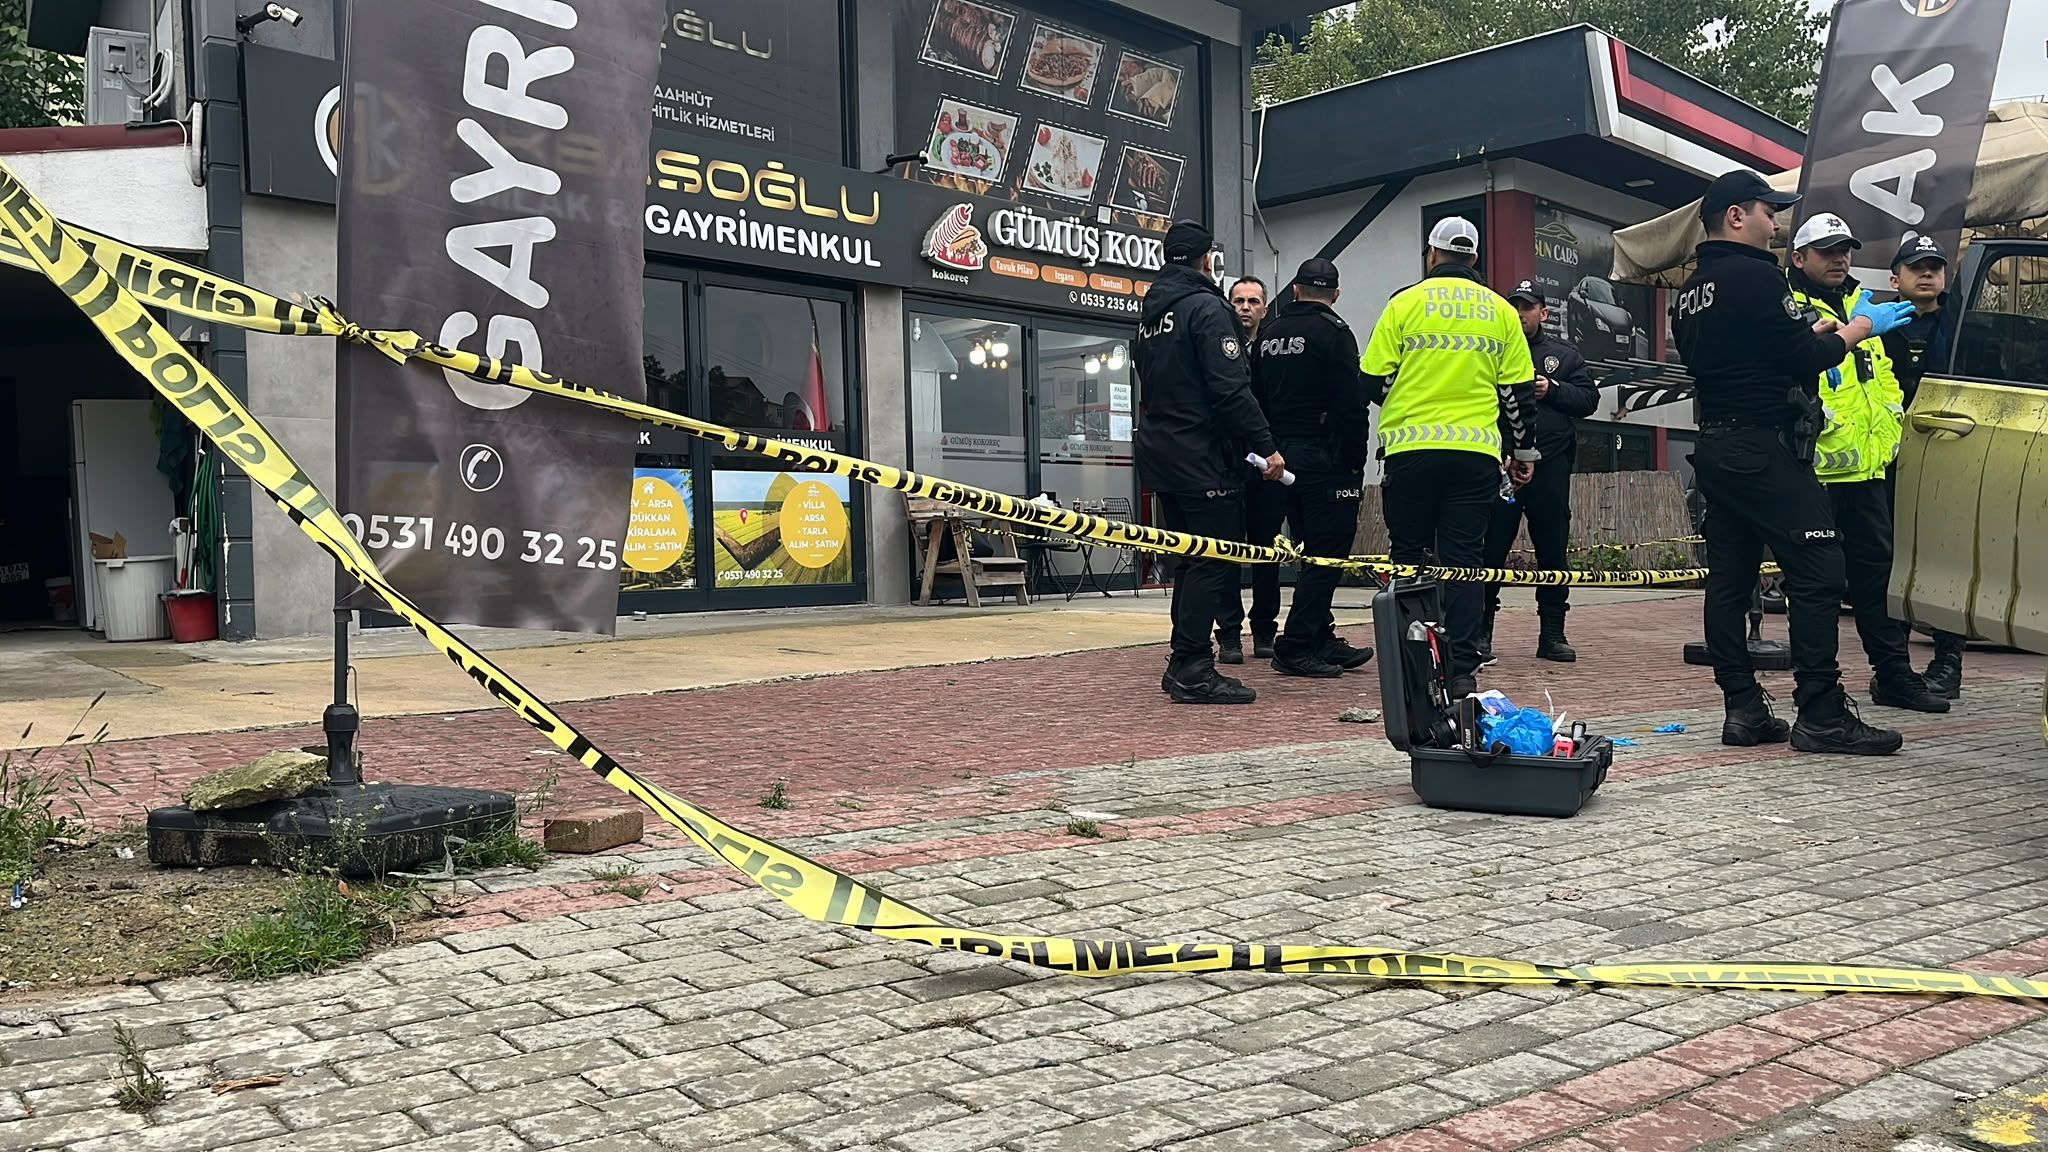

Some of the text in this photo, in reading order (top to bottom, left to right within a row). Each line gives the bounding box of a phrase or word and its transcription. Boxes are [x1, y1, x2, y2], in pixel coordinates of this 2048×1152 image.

[668, 9, 772, 59] ĞLU
[696, 112, 775, 142] HİZMETLERİ
[648, 149, 880, 225] ŞOĞLU
[644, 204, 881, 268] GAYRİMENKUL
[993, 205, 1100, 268] GÜMÜŞ
[1553, 244, 1579, 265] CARS
[995, 259, 1034, 276] Tavuk Pilav
[931, 268, 969, 286] kokoreç
[1099, 277, 1123, 290] Tantuni
[1081, 292, 1105, 308] 0535
[1107, 295, 1125, 311] 235
[1126, 298, 1139, 313] 64
[950, 436, 972, 447] GÜMÜŞ
[648, 500, 673, 508] ARSA
[803, 499, 826, 509] VİLLA
[630, 512, 671, 523] DÜKKAN
[804, 514, 826, 522] ARSA
[627, 526, 677, 537] KİRALAMA
[802, 527, 828, 535] TARLA
[341, 513, 618, 571] 0531 490 32 25
[624, 542, 646, 551] ALIM
[654, 542, 682, 551] SATIM
[788, 541, 809, 549] ALIM
[815, 540, 839, 548] SATIM
[724, 568, 783, 580] 0531 490 32 25
